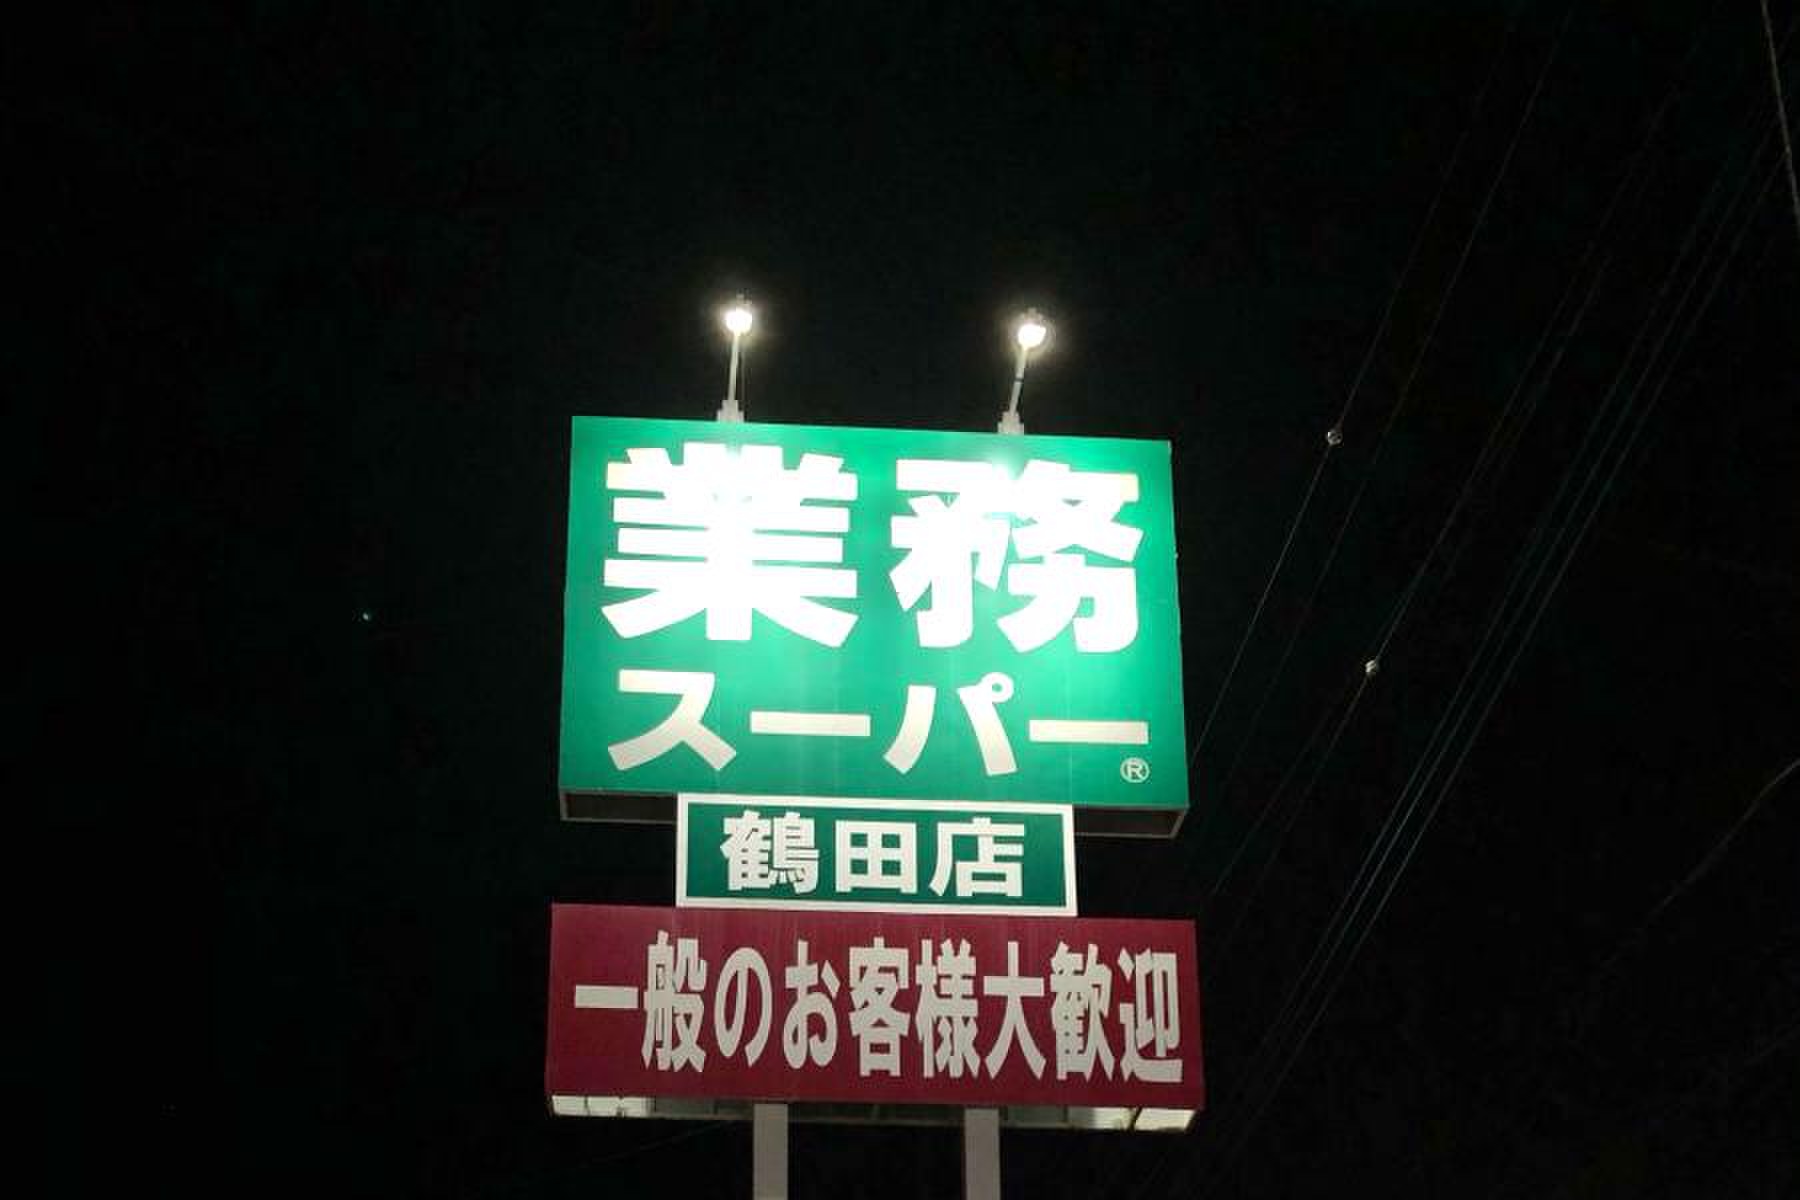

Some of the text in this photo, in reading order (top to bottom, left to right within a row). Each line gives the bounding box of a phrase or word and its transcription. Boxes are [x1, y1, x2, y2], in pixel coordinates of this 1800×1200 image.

[602, 441, 1142, 654] 業務
[607, 669, 1149, 776] スーパー
[720, 809, 1025, 897] 鶴田店
[574, 930, 1184, 1084] 一般のお客様大歓迎
